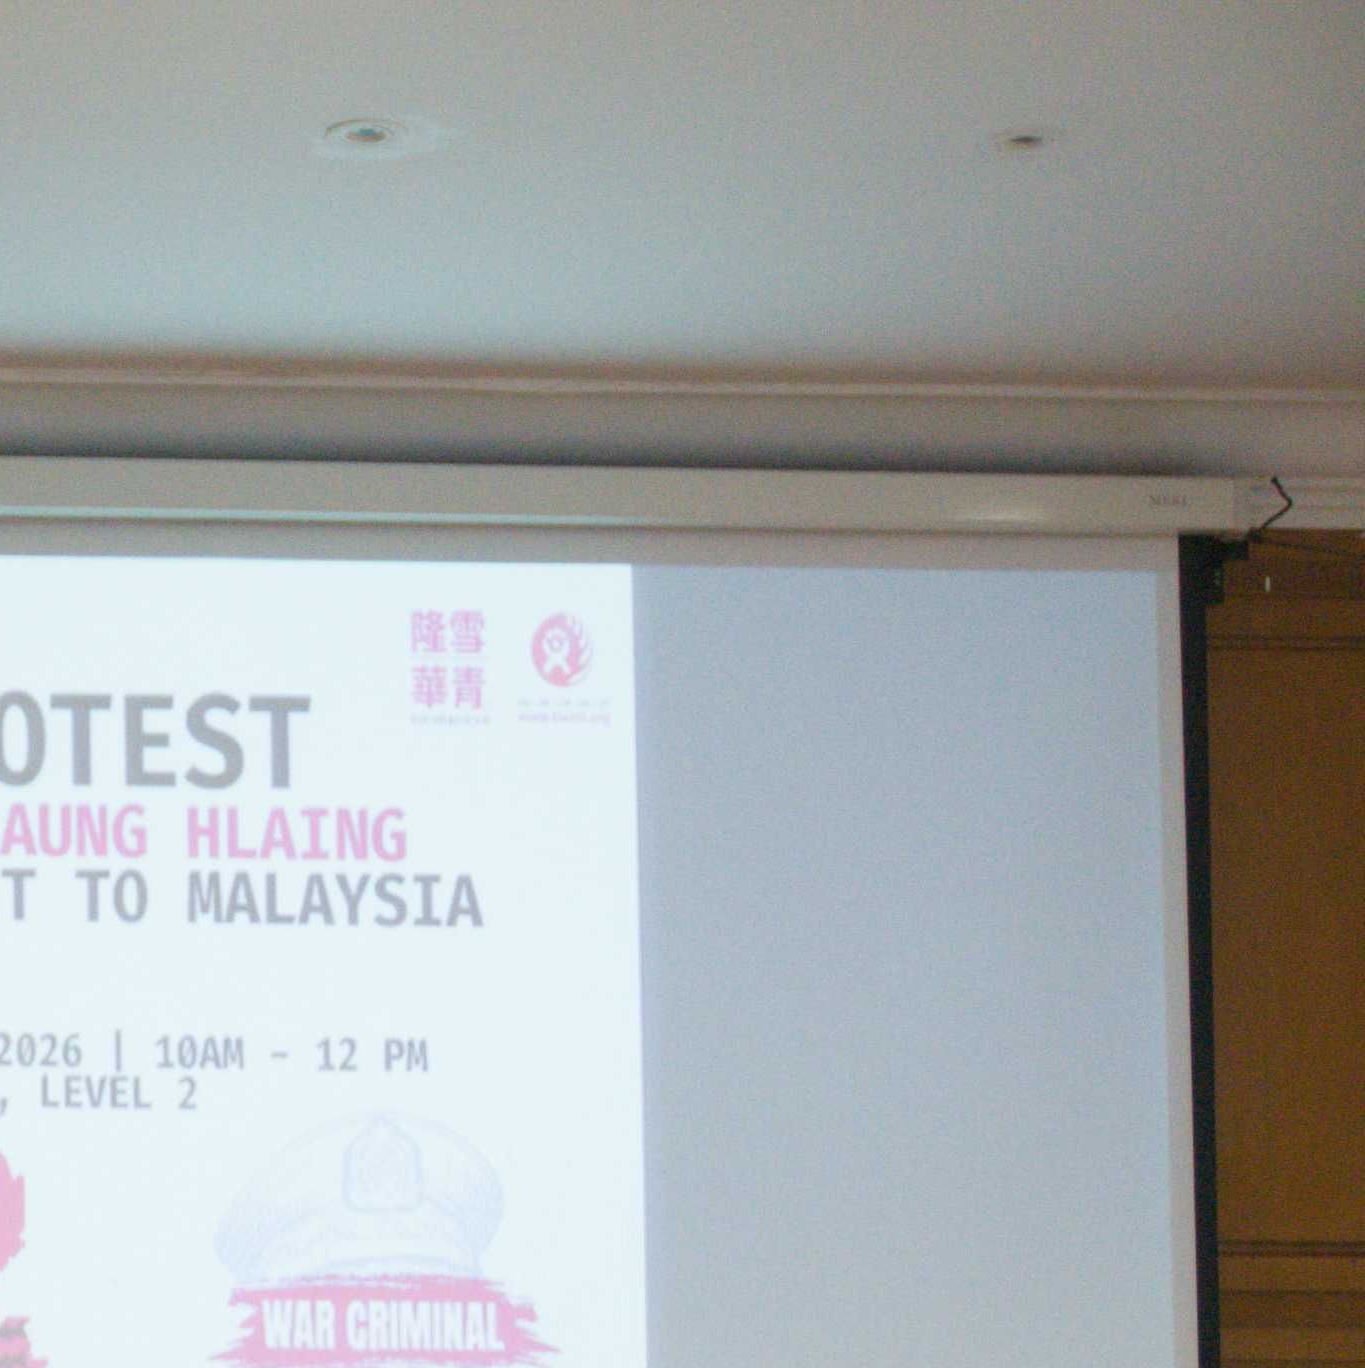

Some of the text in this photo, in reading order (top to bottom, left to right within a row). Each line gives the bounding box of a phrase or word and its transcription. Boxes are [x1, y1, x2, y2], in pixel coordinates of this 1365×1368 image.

[0, 804, 147, 857] AUNG
[187, 807, 407, 861] HLAING
[75, 869, 148, 923] TO
[187, 871, 484, 927] MALAYSIA
[156, 1035, 245, 1070] 10AM
[317, 1037, 358, 1072] 12
[383, 1038, 430, 1073] PM
[40, 1075, 152, 1110] LEVEL
[178, 1076, 197, 1111] 2
[262, 1299, 505, 1351] WAR CRIMINAL
